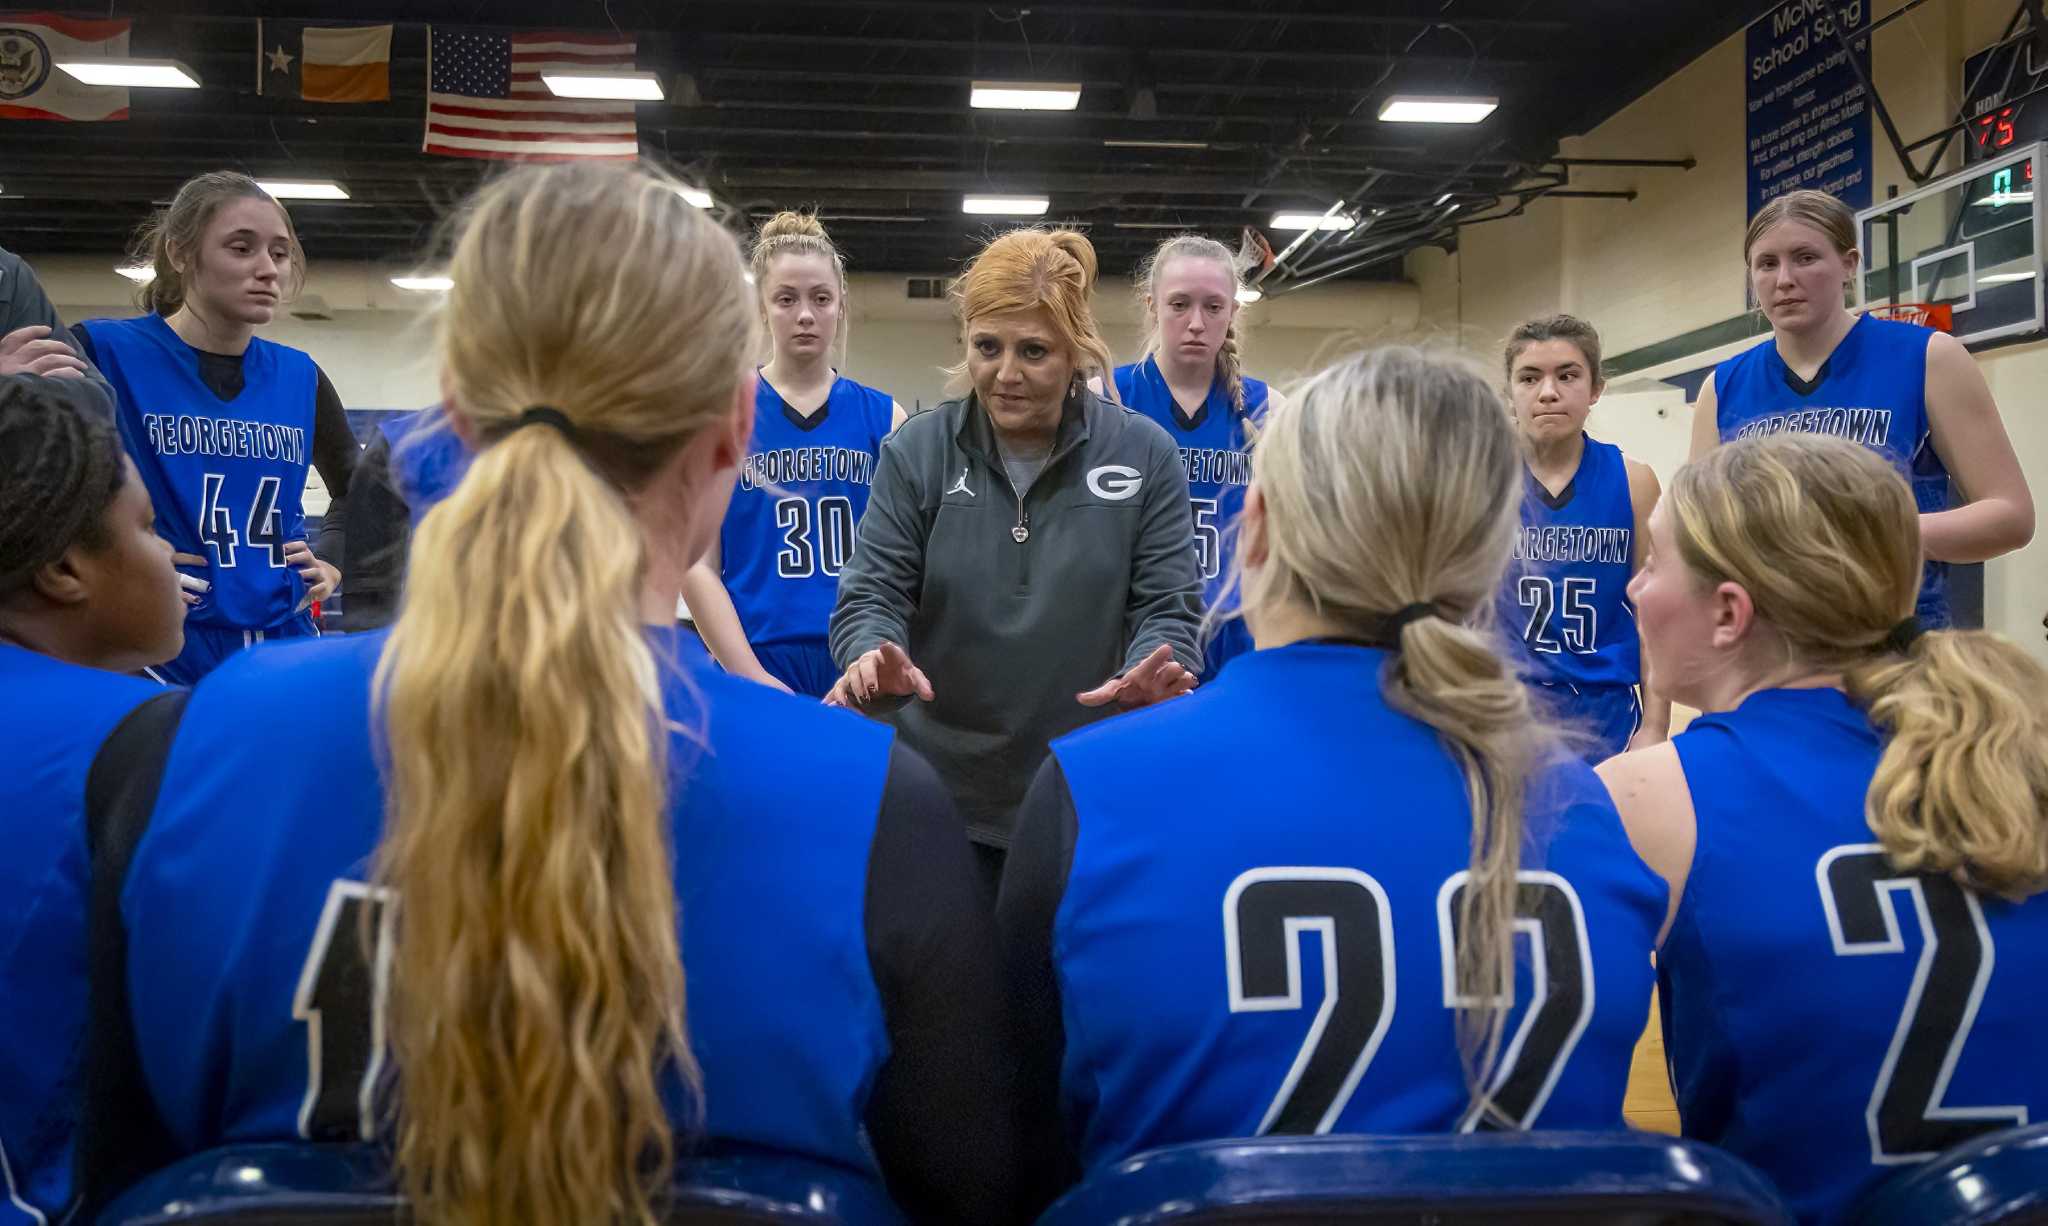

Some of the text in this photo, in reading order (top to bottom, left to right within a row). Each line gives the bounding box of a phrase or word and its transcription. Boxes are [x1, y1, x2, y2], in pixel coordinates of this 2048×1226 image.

[1752, 1, 1861, 81] School Song
[1773, 0, 1825, 39] McNe
[1976, 92, 2002, 114] HOM
[1979, 107, 2014, 147] 75
[144, 413, 304, 466] GEORGETOWN
[200, 473, 283, 569] 44
[1086, 465, 1143, 501] G
[776, 496, 855, 579] 30
[1190, 498, 1220, 580] 5
[1512, 526, 1629, 564] ORGETOWN
[1518, 576, 1597, 654] 25
[1222, 866, 1596, 1136] 22
[1815, 843, 2028, 1166] 2
